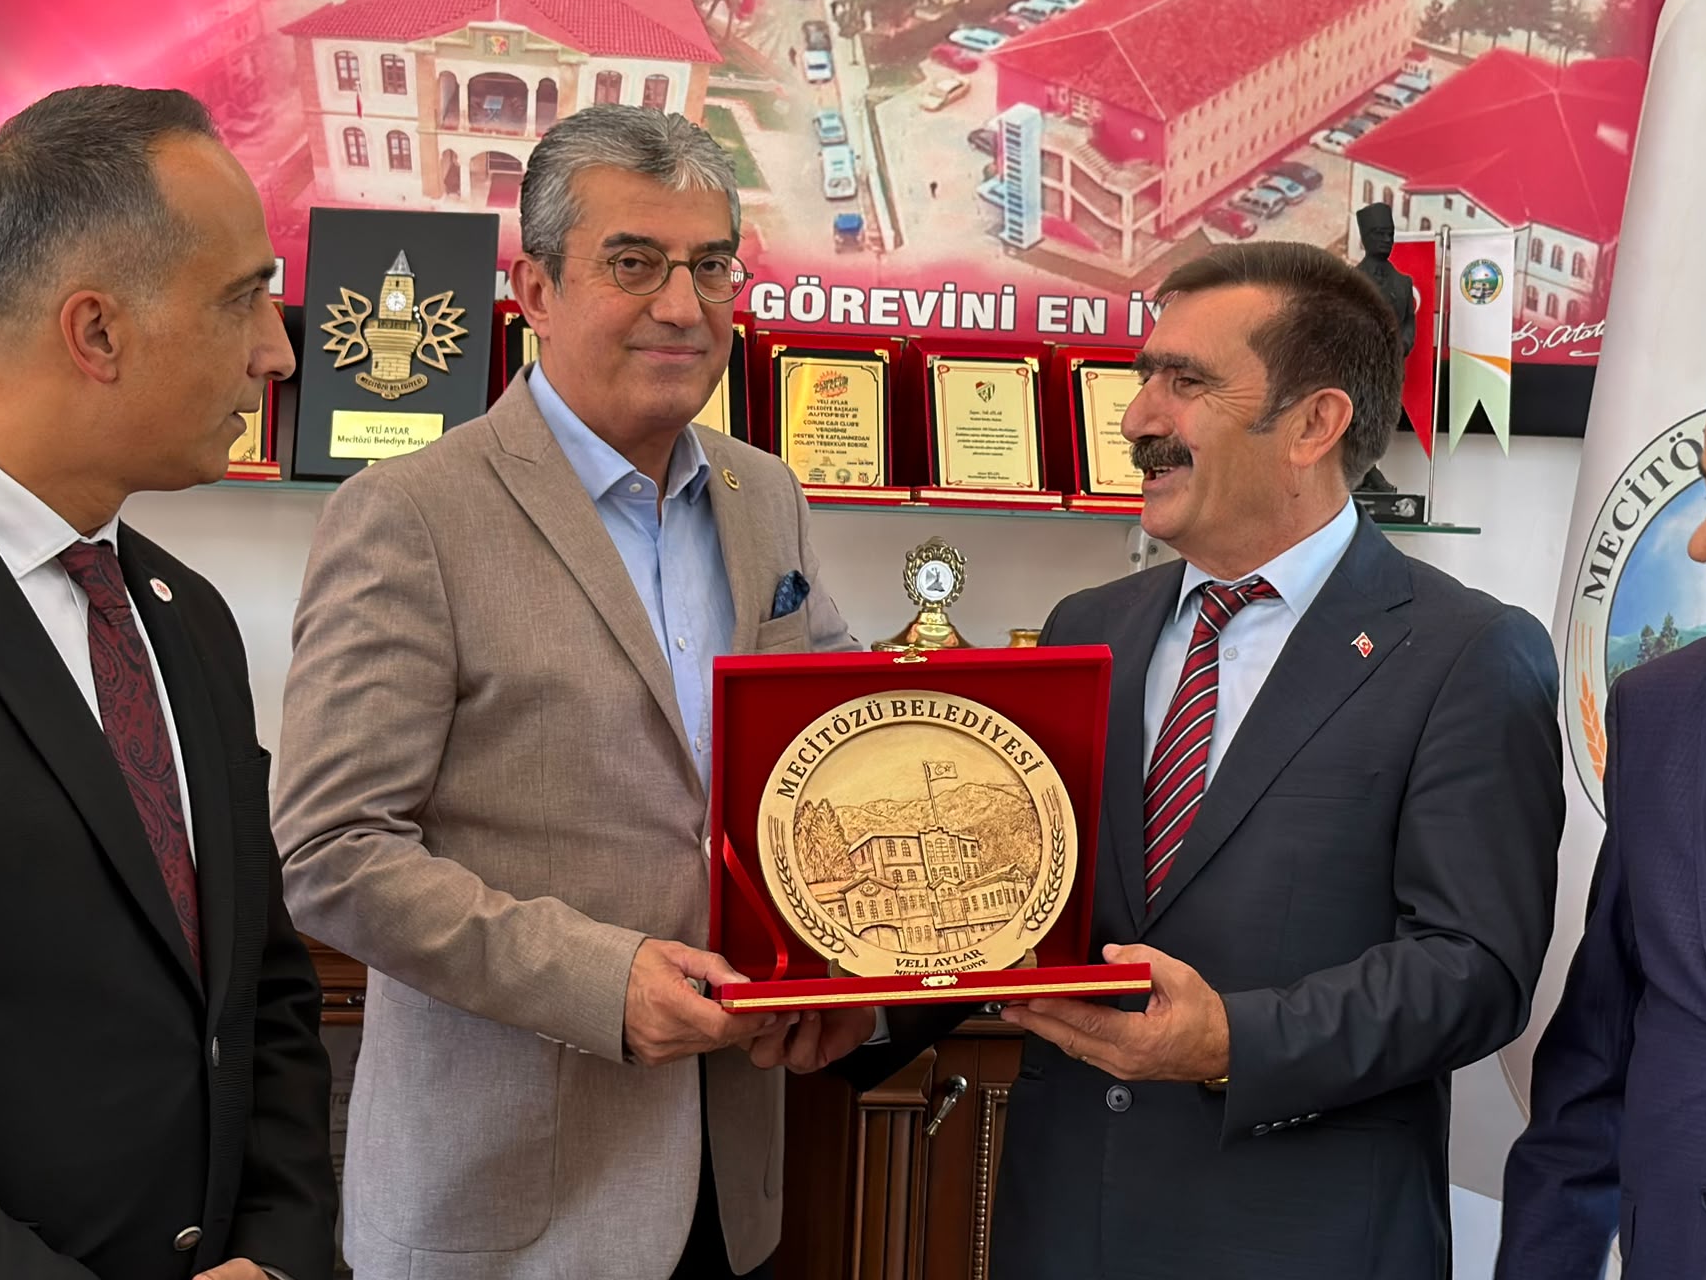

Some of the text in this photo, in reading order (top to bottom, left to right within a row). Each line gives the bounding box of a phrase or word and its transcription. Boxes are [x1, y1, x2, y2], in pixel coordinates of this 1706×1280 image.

[749, 275, 1016, 332] GÖREVİNİ
[1038, 294, 1108, 336] EN
[374, 436, 405, 447] Belediye
[776, 699, 1046, 799] MECİTÖZÜ BELEDİYESİ
[895, 949, 984, 968] VELİ AYLAR
